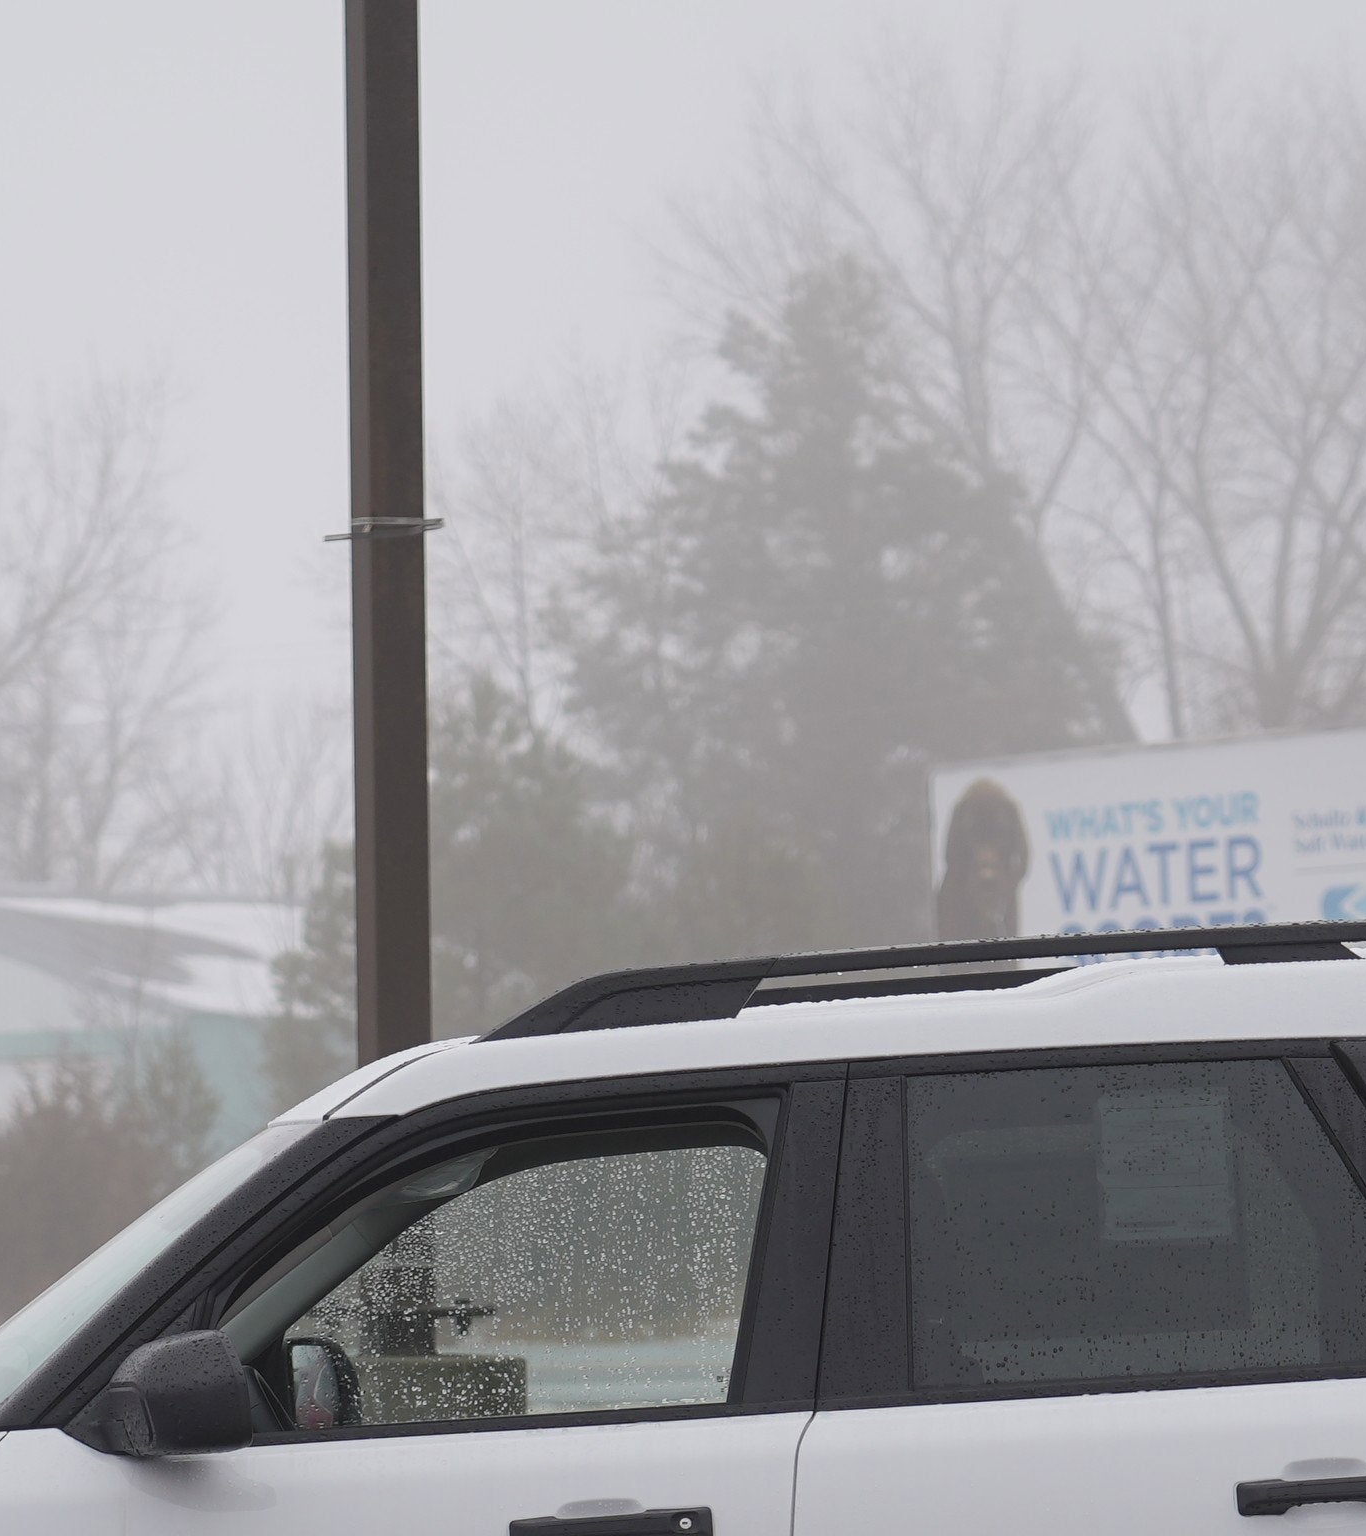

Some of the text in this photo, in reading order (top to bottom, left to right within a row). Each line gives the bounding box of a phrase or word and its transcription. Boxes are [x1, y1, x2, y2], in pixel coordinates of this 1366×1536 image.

[1044, 791, 1259, 842] WHAT'S YOUR
[1049, 834, 1266, 915] WATER
